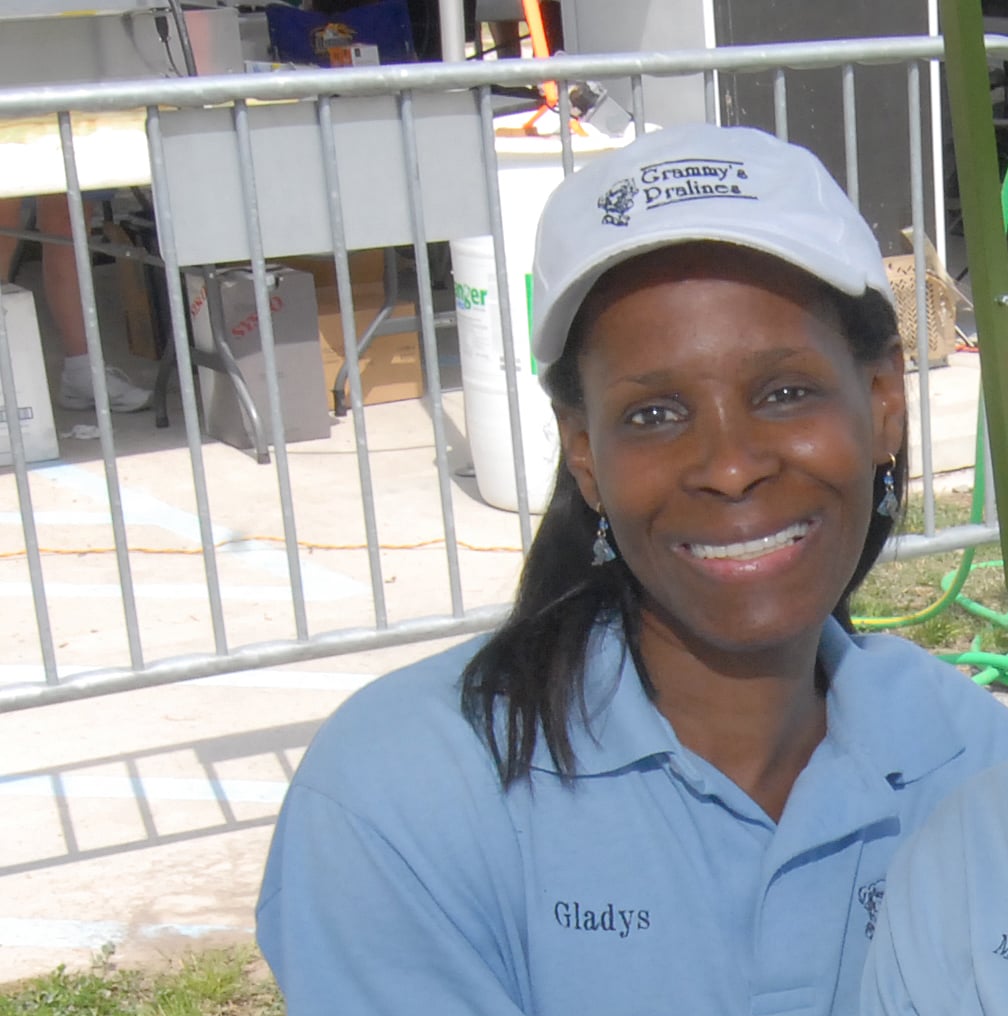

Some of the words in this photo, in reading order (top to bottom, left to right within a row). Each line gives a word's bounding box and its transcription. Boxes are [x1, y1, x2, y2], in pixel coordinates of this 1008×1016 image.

[640, 164, 748, 185] Grammy's
[643, 180, 741, 203] Pralines
[554, 900, 650, 938] Gladys
